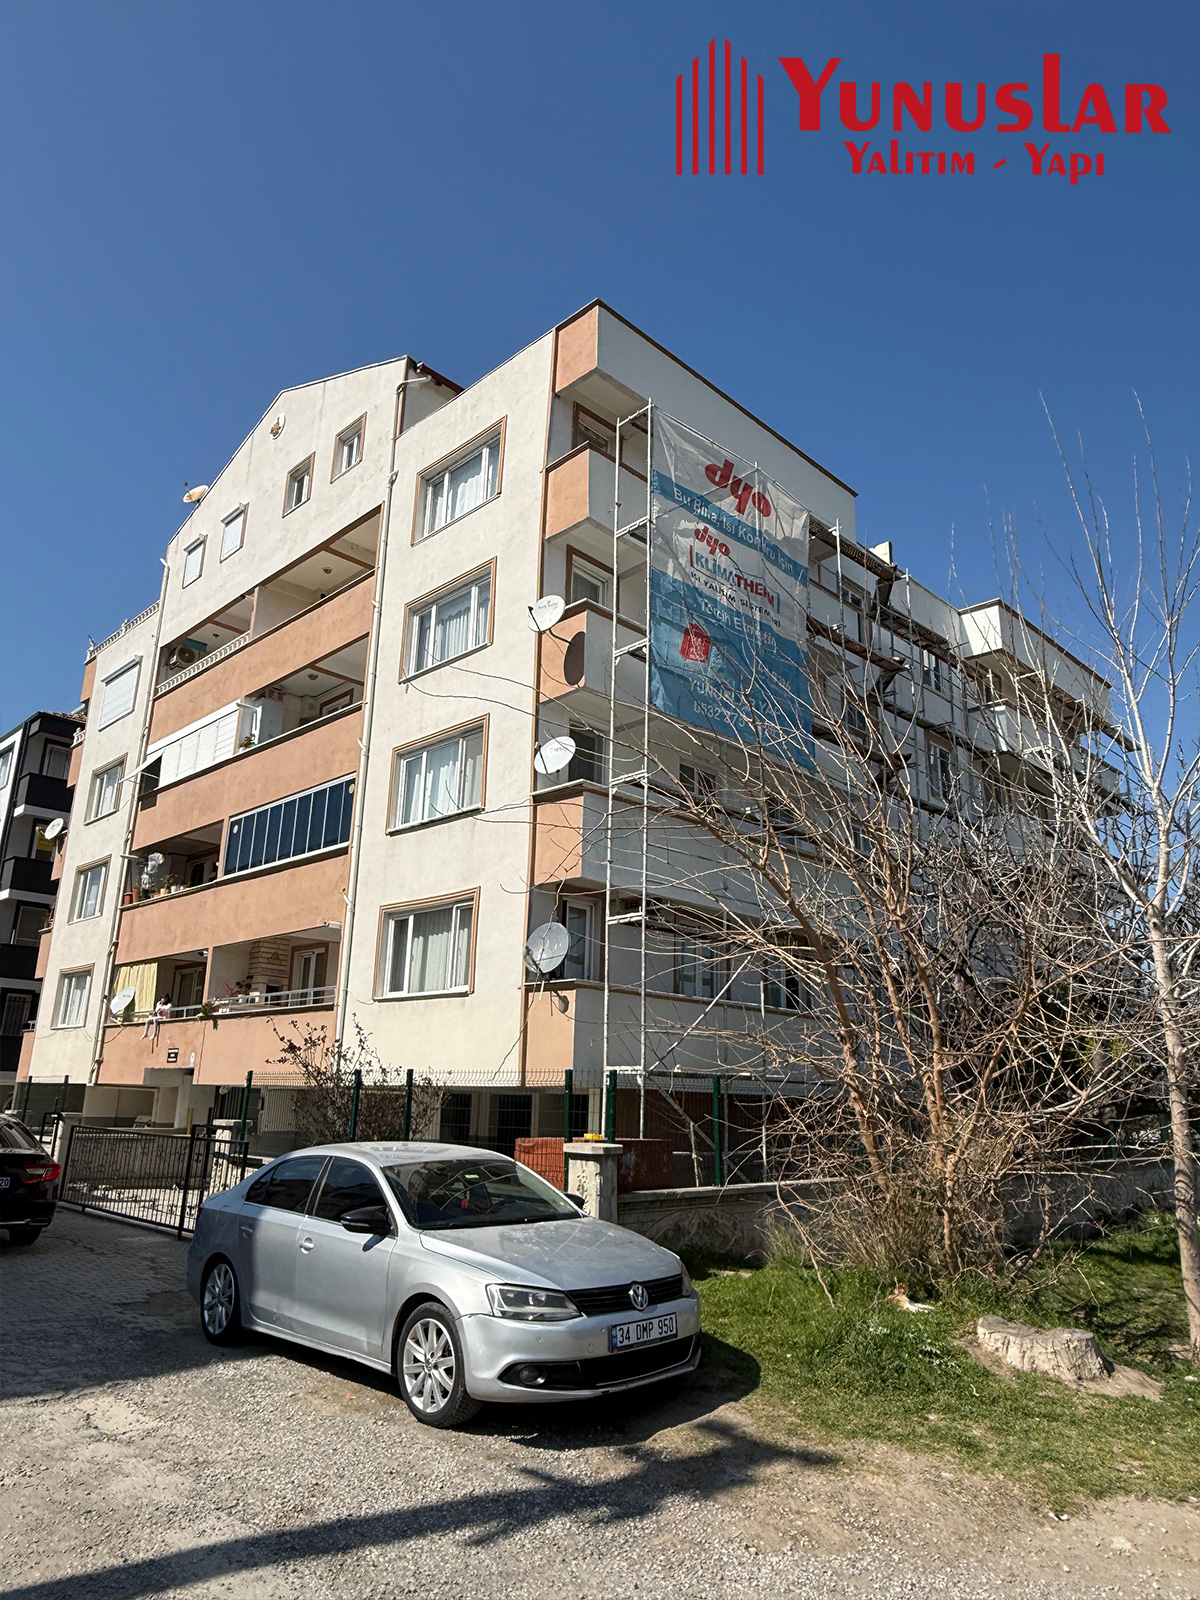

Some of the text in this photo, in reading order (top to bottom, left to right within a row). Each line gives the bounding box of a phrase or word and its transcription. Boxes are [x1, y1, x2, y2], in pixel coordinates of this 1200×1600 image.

[674, 487, 690, 505] Bu
[705, 459, 772, 518] dyo
[694, 525, 731, 556] dyo
[618, 1317, 674, 1344] 34 DMP 950
